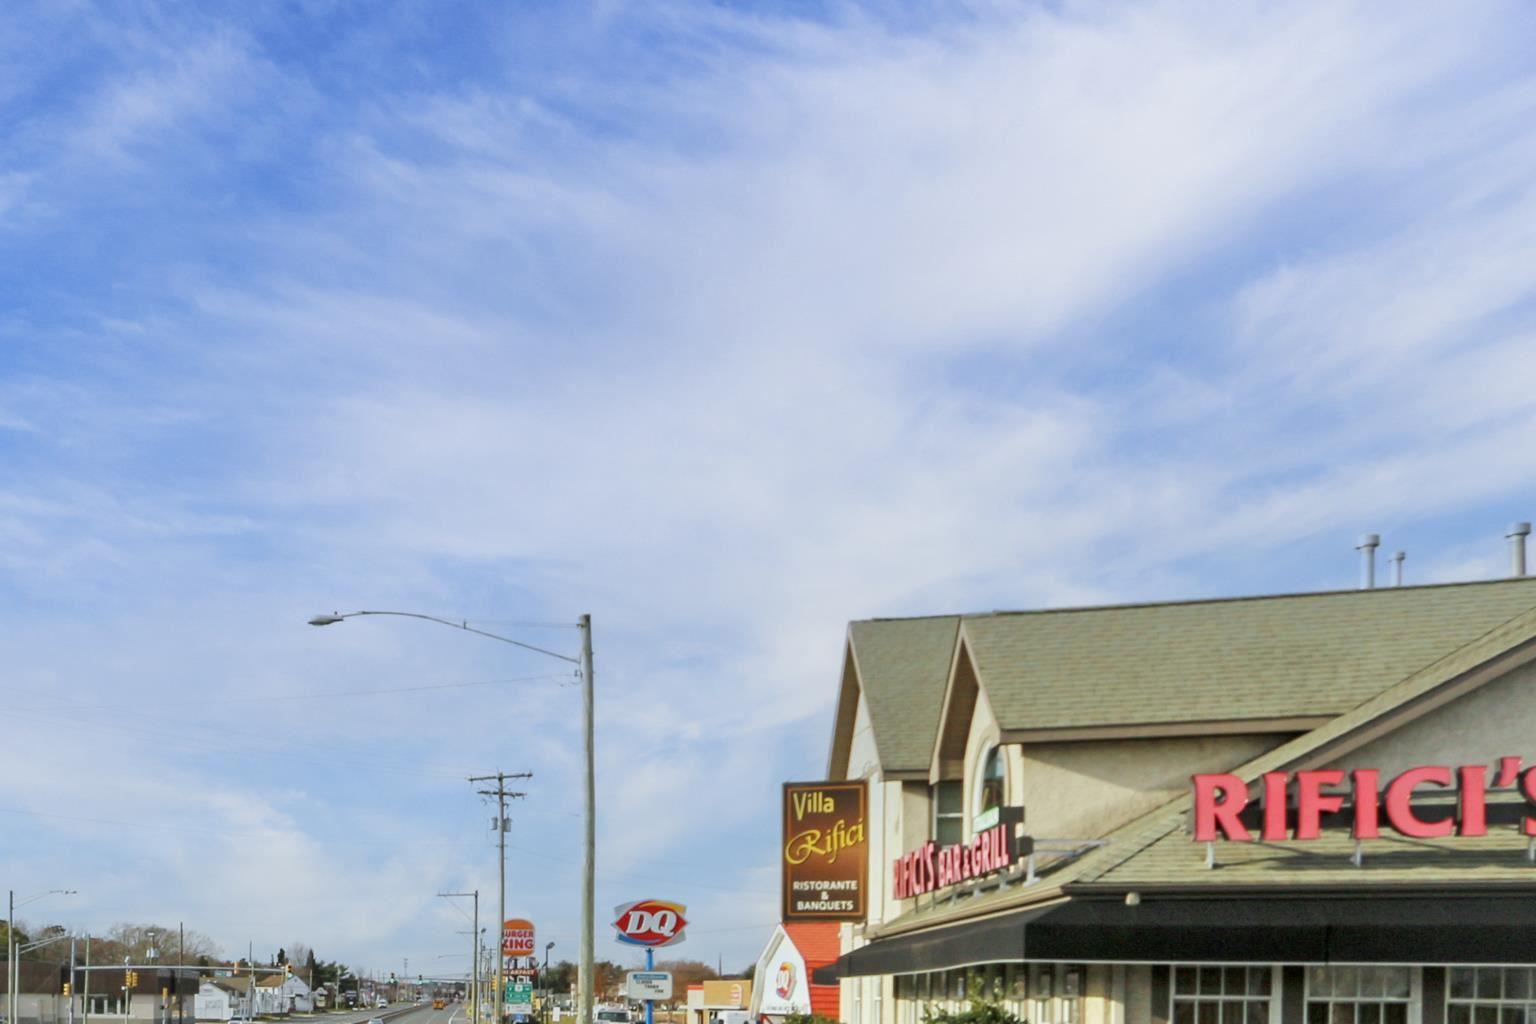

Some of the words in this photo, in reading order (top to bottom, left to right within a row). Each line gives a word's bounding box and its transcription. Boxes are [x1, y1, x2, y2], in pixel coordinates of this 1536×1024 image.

[793, 792, 835, 821] Villa
[1192, 756, 1536, 842] RIFICI'
[785, 818, 865, 864] Rifici
[938, 844, 964, 888] BAR
[963, 849, 972, 878] &
[971, 823, 1010, 878] GRILL
[793, 880, 858, 891] RISTORANTE
[820, 891, 829, 900] &
[797, 900, 854, 911] BANQUETS
[502, 930, 534, 938] URGER
[625, 909, 678, 937] DQ
